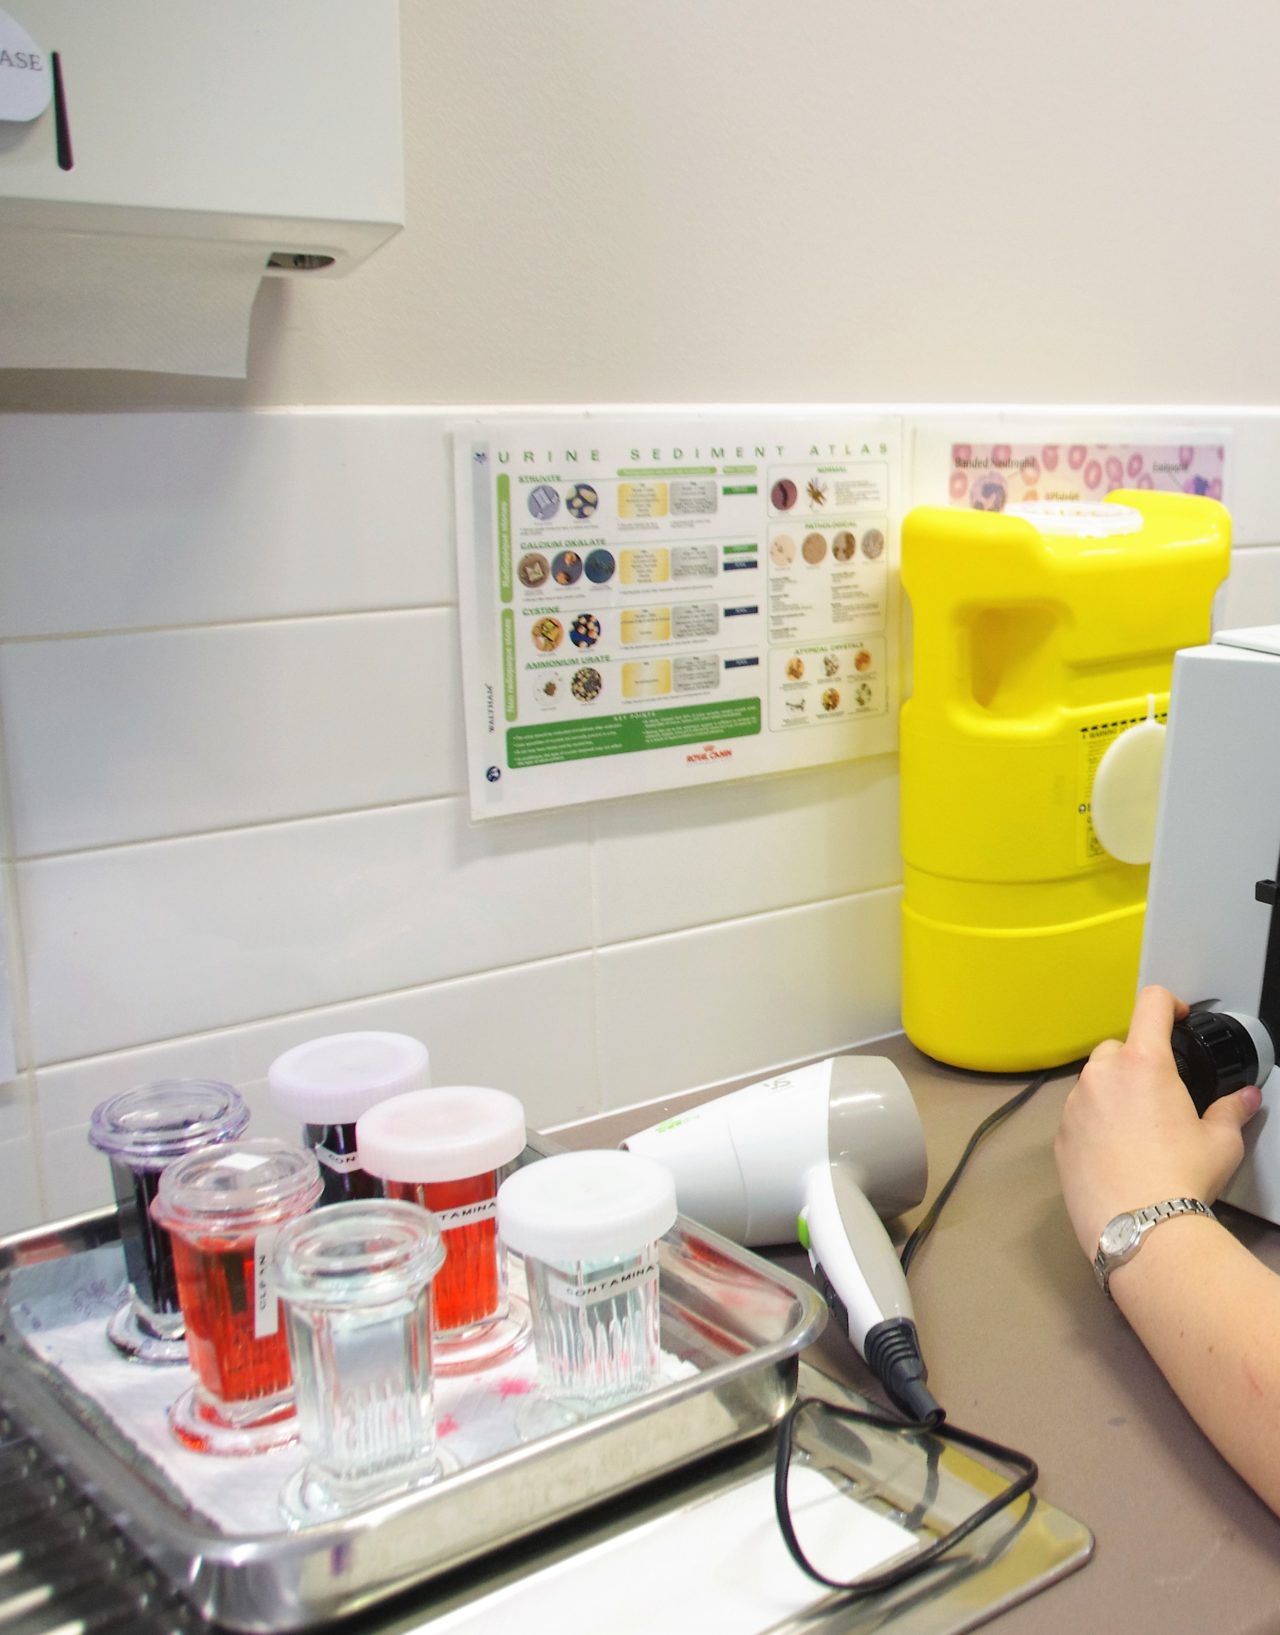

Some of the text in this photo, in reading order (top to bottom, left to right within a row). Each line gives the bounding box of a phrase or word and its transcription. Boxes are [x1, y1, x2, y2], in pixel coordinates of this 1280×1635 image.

[0, 50, 43, 71] ASE
[497, 443, 888, 465] URINE SEDIMENT ATLAS
[520, 537, 607, 551] CALCIUM OXALATE
[565, 1265, 655, 1298] CONTAMINA
